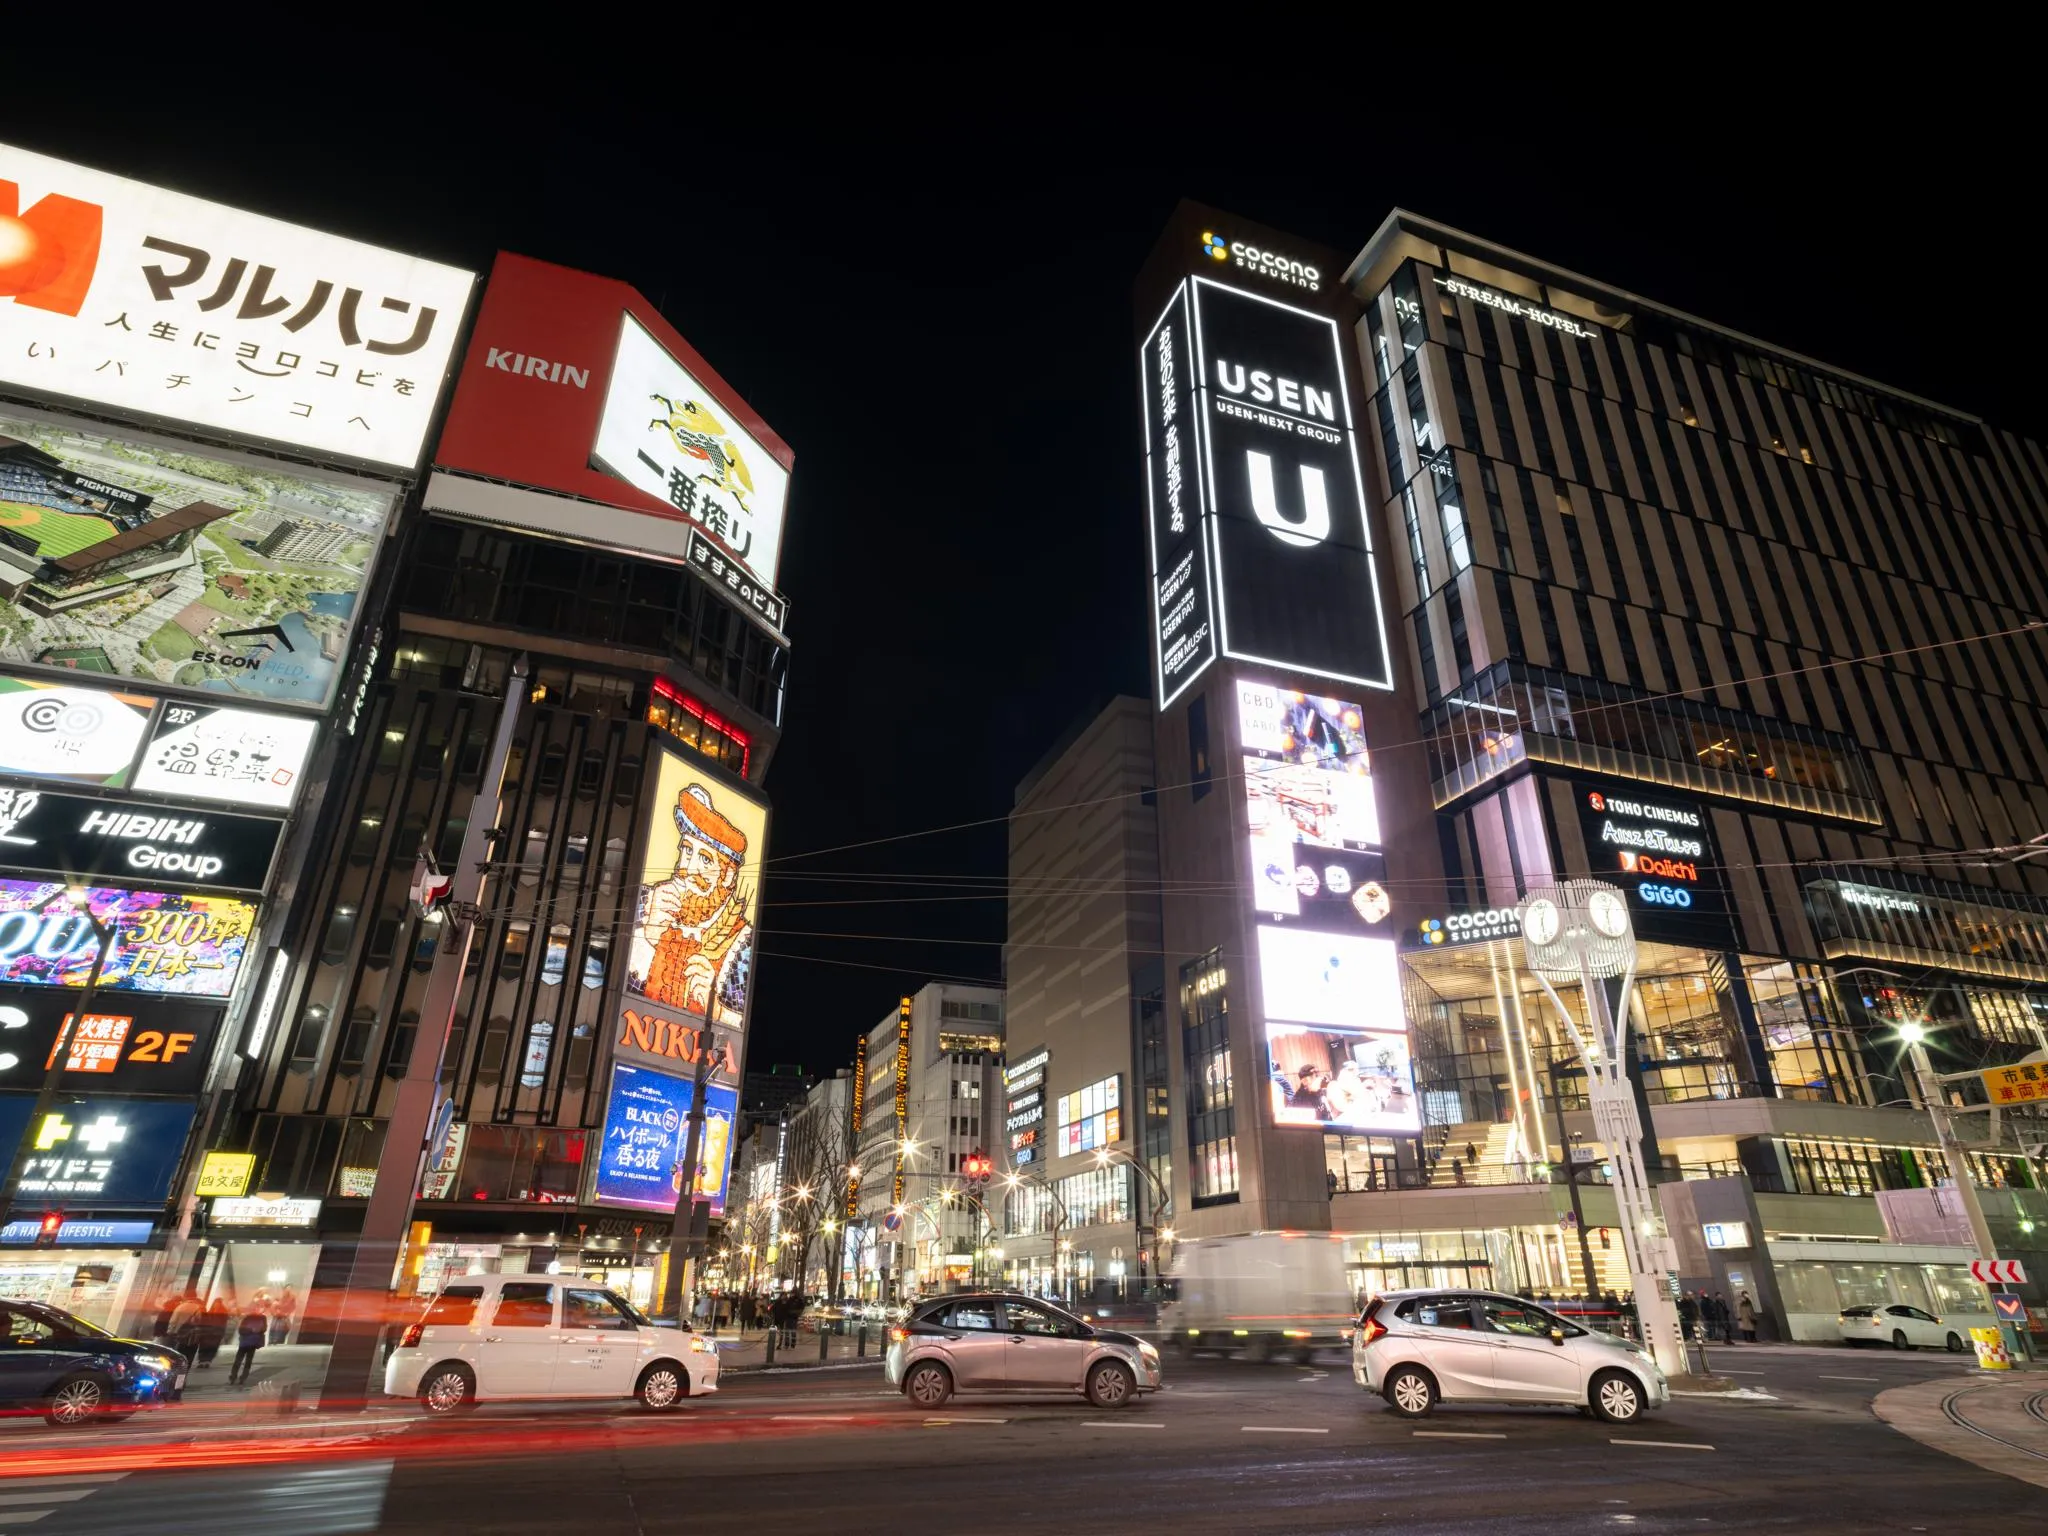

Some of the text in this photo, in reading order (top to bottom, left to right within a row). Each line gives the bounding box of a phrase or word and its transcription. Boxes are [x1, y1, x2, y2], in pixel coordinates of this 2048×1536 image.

[142, 235, 438, 355] マルハン
[1446, 279, 1521, 316] STREAM
[1528, 307, 1586, 339] HOTEL
[104, 312, 415, 397] 人生にヨロコビを
[485, 347, 590, 389] KIRIN
[1217, 359, 1335, 421] USEN
[1216, 402, 1342, 445] USEN-NEXT GROUP
[75, 477, 137, 503] FIGHTERS
[637, 448, 752, 559] 一番搾り
[1247, 449, 1330, 546] U
[694, 545, 780, 621] すすきのビル
[1161, 579, 1180, 607] USEN
[1162, 616, 1182, 641] USEN
[1181, 597, 1195, 623] PAY
[191, 650, 216, 664] ES
[219, 654, 261, 671] CON
[1165, 650, 1184, 675] USEN
[1183, 622, 1208, 657] MUSIC
[165, 707, 196, 724] 2F
[80, 811, 206, 844] HIBIKI
[1607, 798, 1699, 827] TOHO CINEMAS
[128, 845, 222, 878] Group
[1639, 855, 1697, 881] Daiichi
[126, 908, 242, 948] 300坪
[1451, 923, 1518, 942] SUSUKIN
[127, 946, 225, 979] 日本一
[62, 1017, 129, 1040] 火焼き
[128, 1030, 197, 1064] 2F
[626, 1107, 662, 1127] BLACK
[610, 1126, 671, 1149] ハイボール
[615, 1143, 661, 1170] 香る夜
[201, 1175, 244, 1188] 四文屋
[57, 1225, 114, 1238] LIFESTYLE
